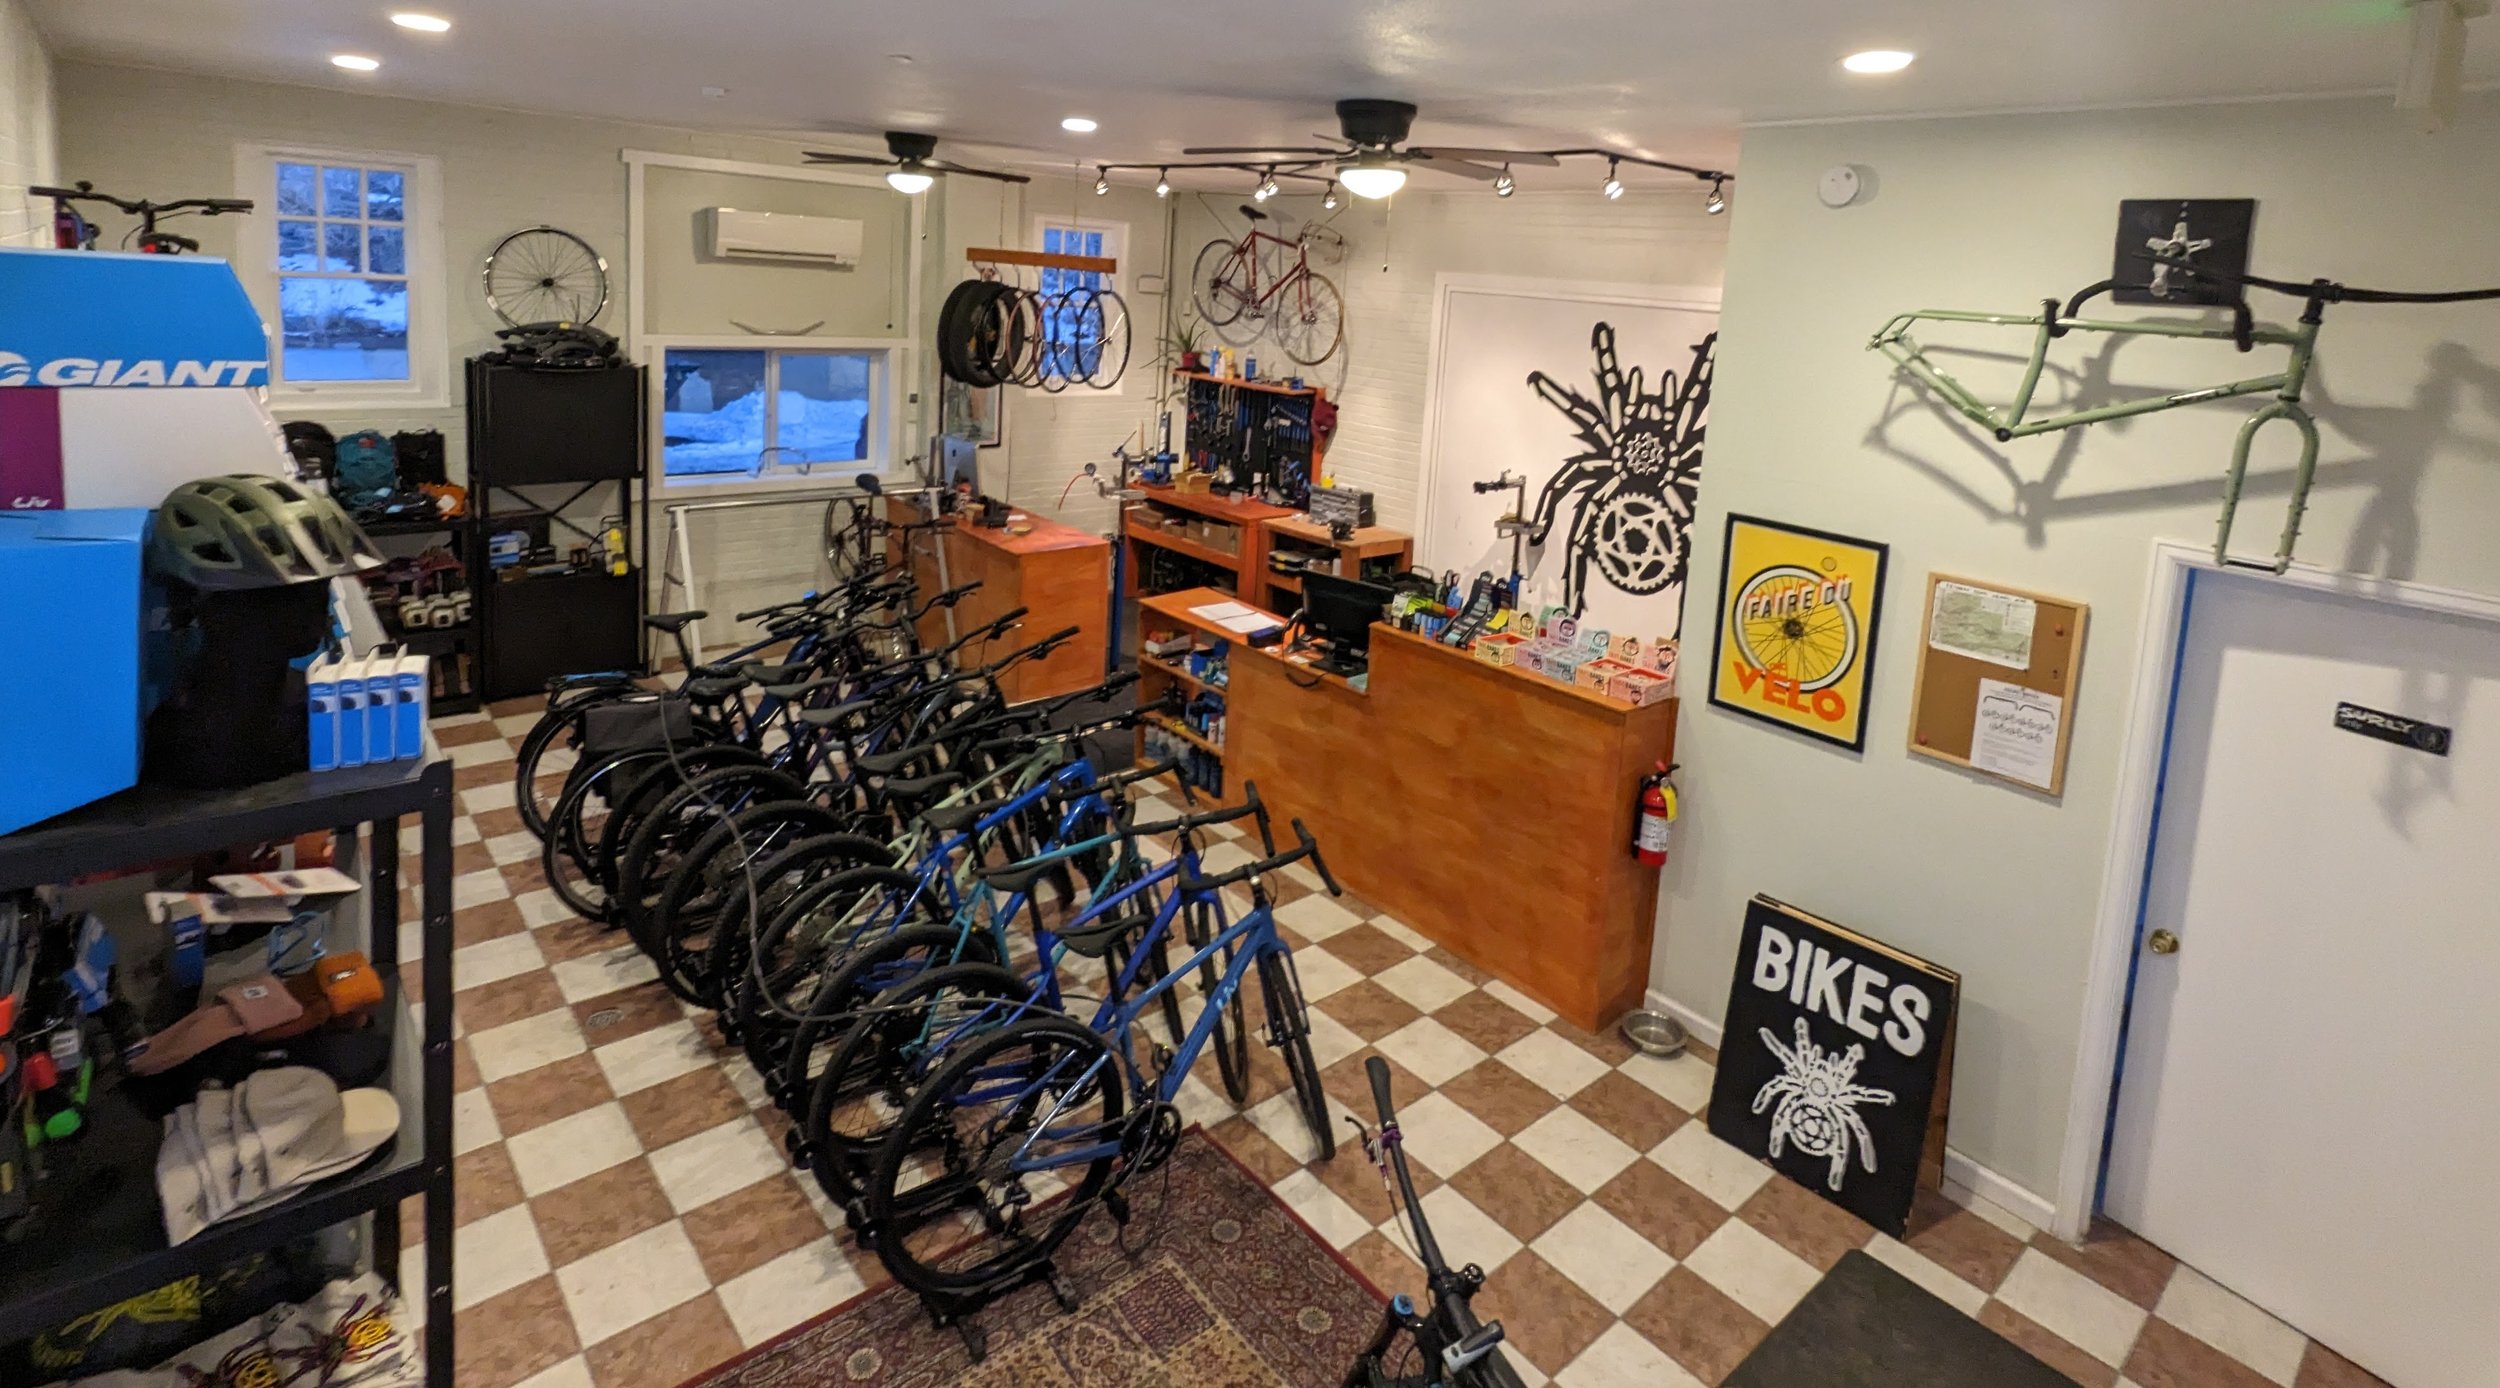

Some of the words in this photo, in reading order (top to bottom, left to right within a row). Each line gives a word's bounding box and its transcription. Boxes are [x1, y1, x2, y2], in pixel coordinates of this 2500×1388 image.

[37, 358, 268, 386] GIANT
[1745, 582, 1814, 620] FAIRE
[1752, 924, 1932, 1058] BIKES
